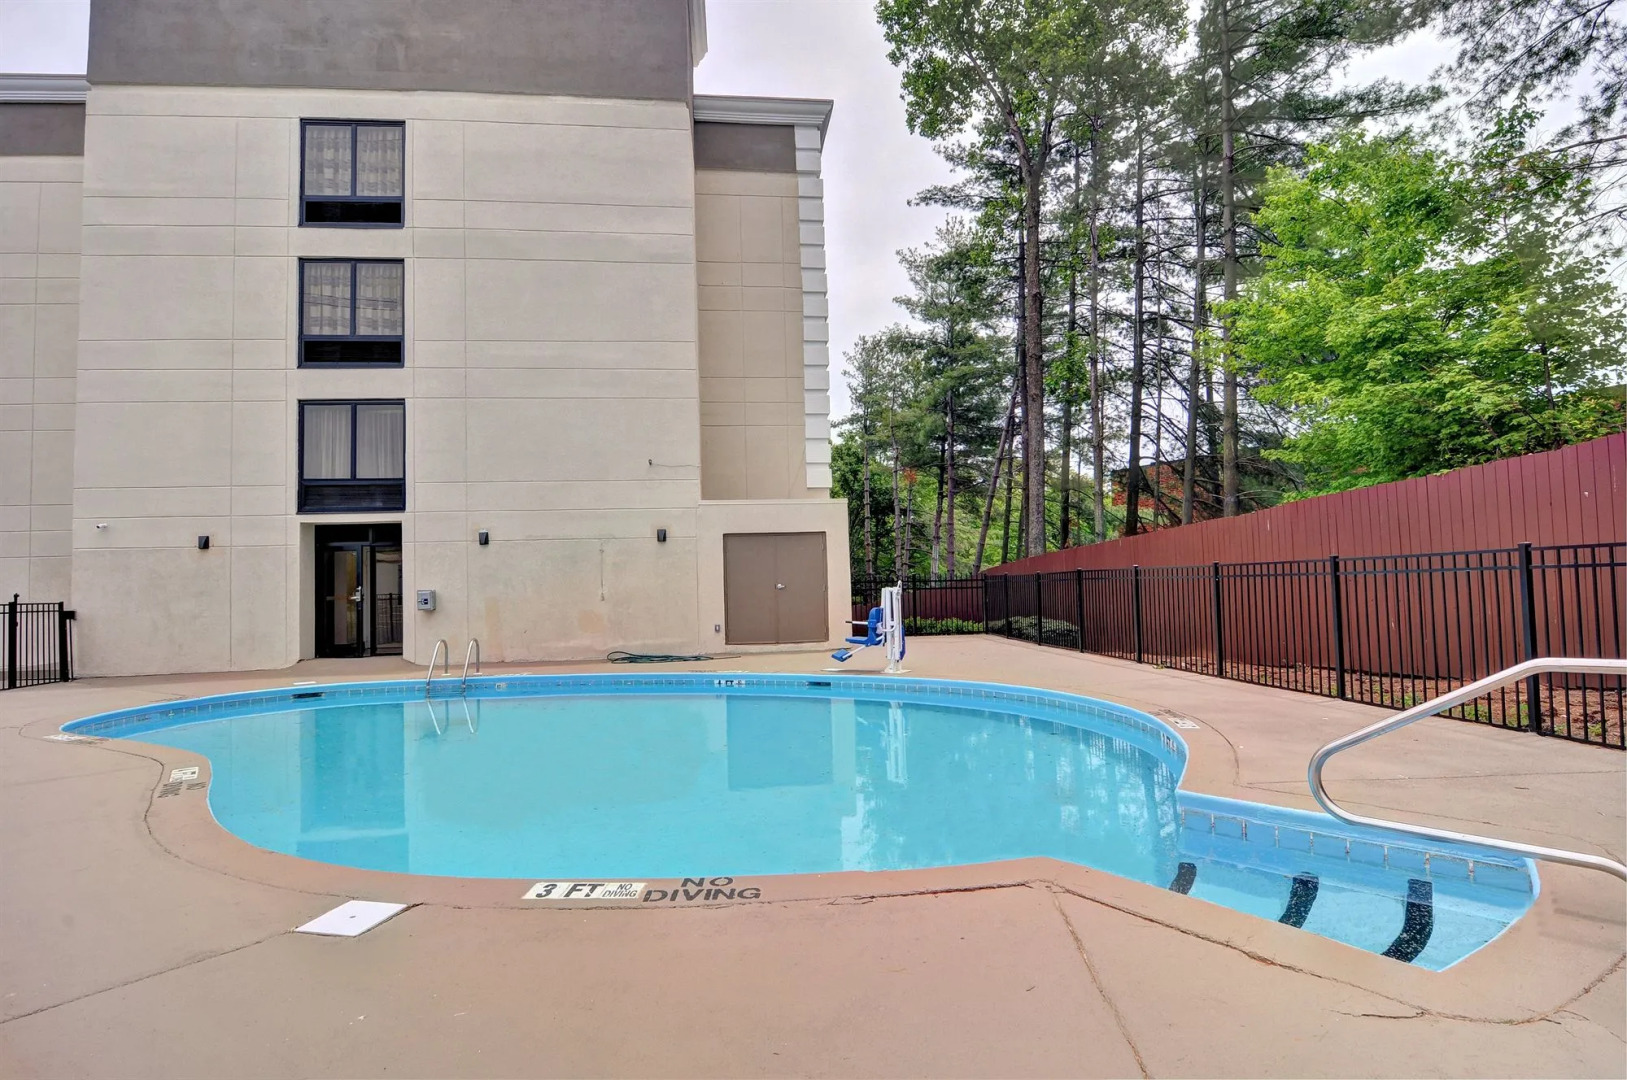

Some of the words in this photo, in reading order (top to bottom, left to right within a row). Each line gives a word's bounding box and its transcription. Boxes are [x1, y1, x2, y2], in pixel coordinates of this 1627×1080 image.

[680, 877, 734, 887] NO
[535, 883, 557, 898] 3
[563, 884, 605, 898] FT
[642, 887, 762, 902] DIVING
